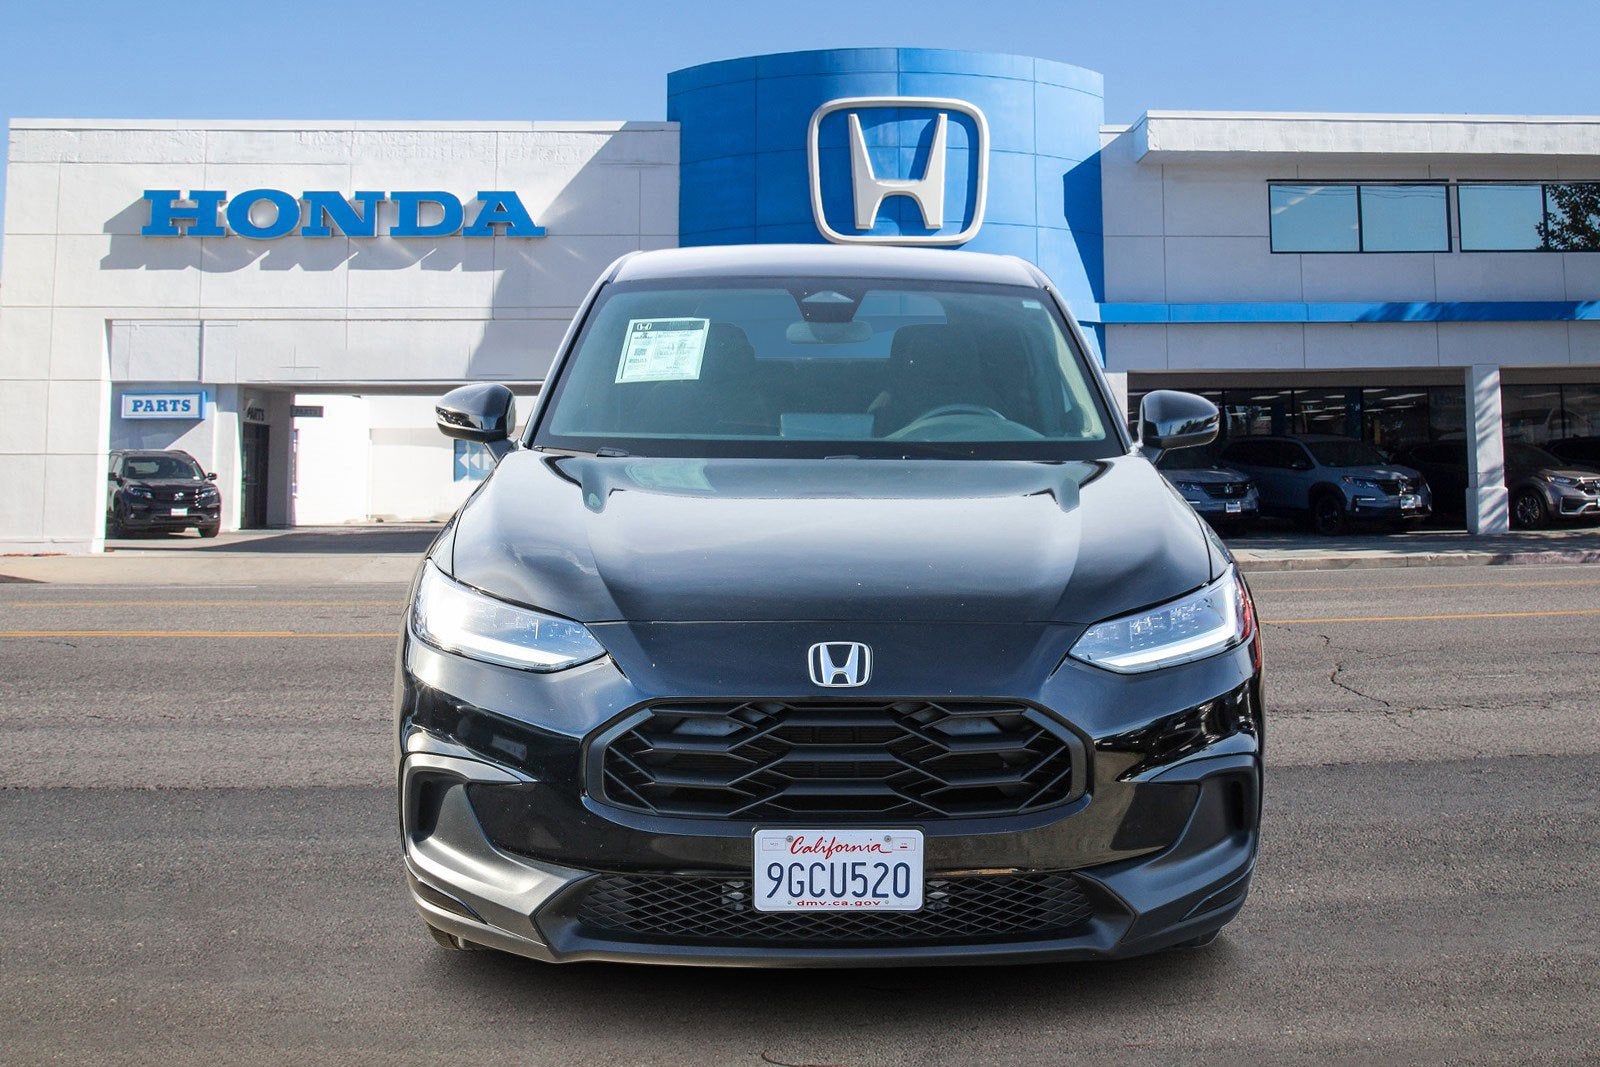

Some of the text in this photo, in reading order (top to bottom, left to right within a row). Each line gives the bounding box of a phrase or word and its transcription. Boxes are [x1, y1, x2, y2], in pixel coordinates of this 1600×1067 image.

[142, 188, 548, 240] HONDA
[132, 399, 191, 412] PARTS
[790, 836, 892, 859] California
[767, 862, 910, 898] 9GCU520
